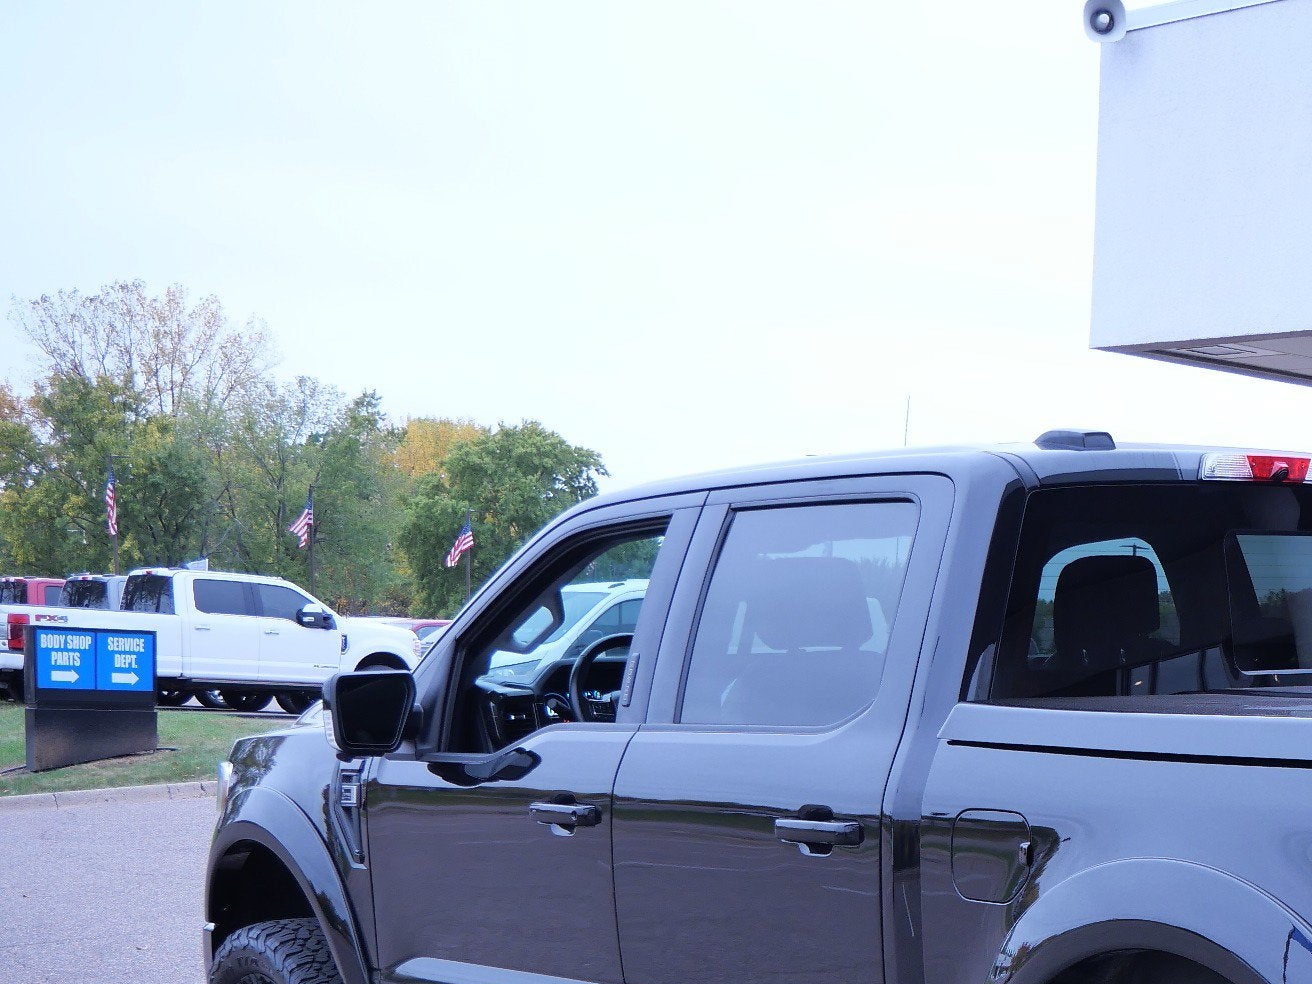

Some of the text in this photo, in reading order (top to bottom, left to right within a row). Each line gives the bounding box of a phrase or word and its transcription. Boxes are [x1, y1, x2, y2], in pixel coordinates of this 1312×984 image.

[40, 634, 92, 650] BODY SHOP
[107, 637, 145, 652] SERVICE
[51, 651, 81, 667] PARTS
[114, 654, 138, 669] DEPT.
